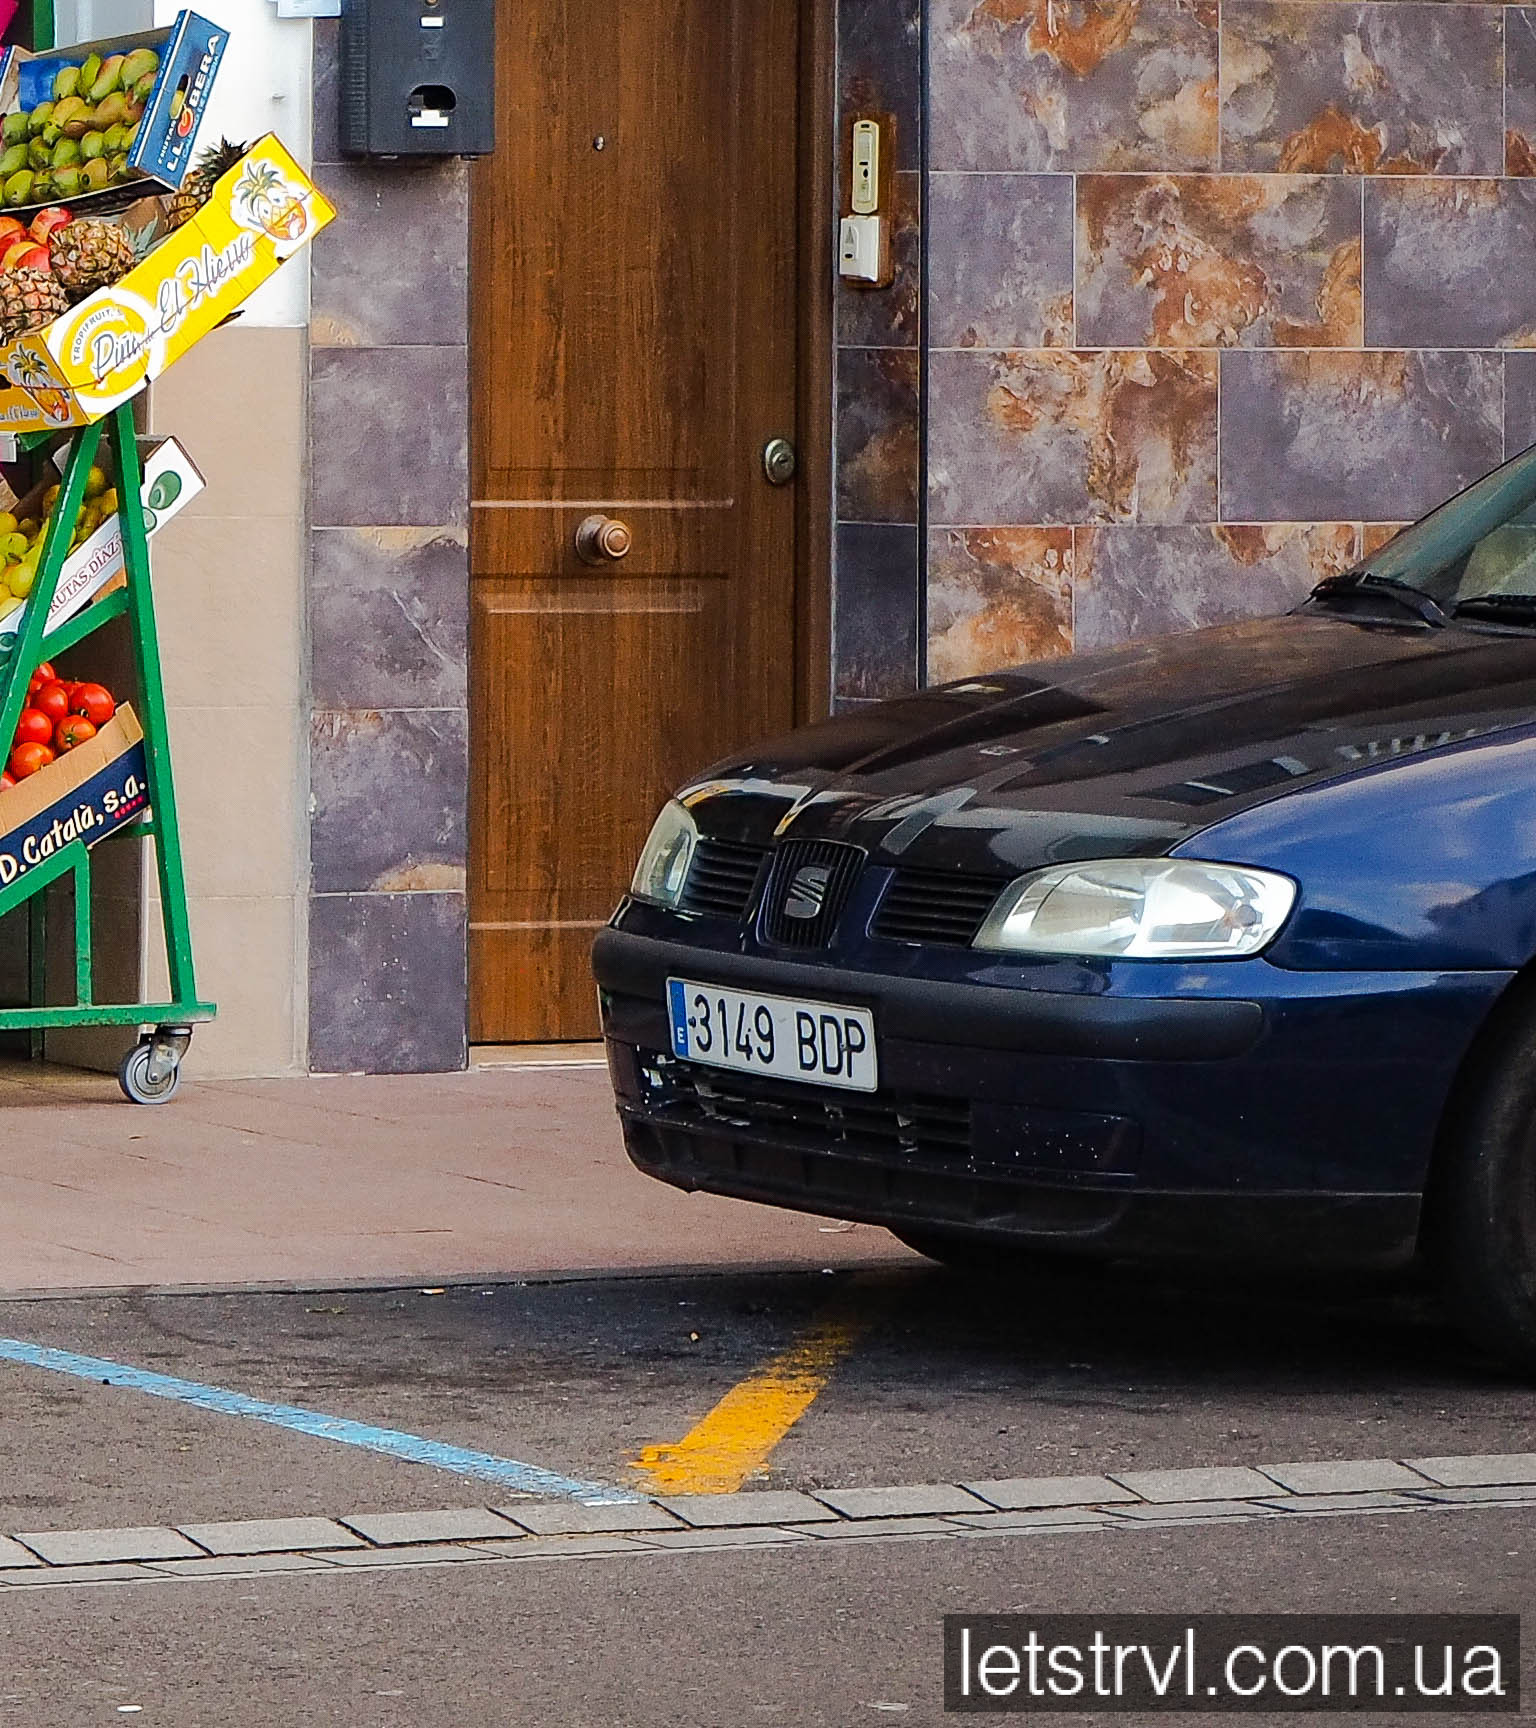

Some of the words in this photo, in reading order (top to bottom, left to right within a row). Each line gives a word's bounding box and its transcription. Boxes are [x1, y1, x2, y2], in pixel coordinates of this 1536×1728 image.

[49, 570, 89, 614] RUTAS
[102, 774, 147, 814] s.a.
[676, 1027, 686, 1045] E
[693, 992, 775, 1065] 3149
[795, 1009, 867, 1079] BDP
